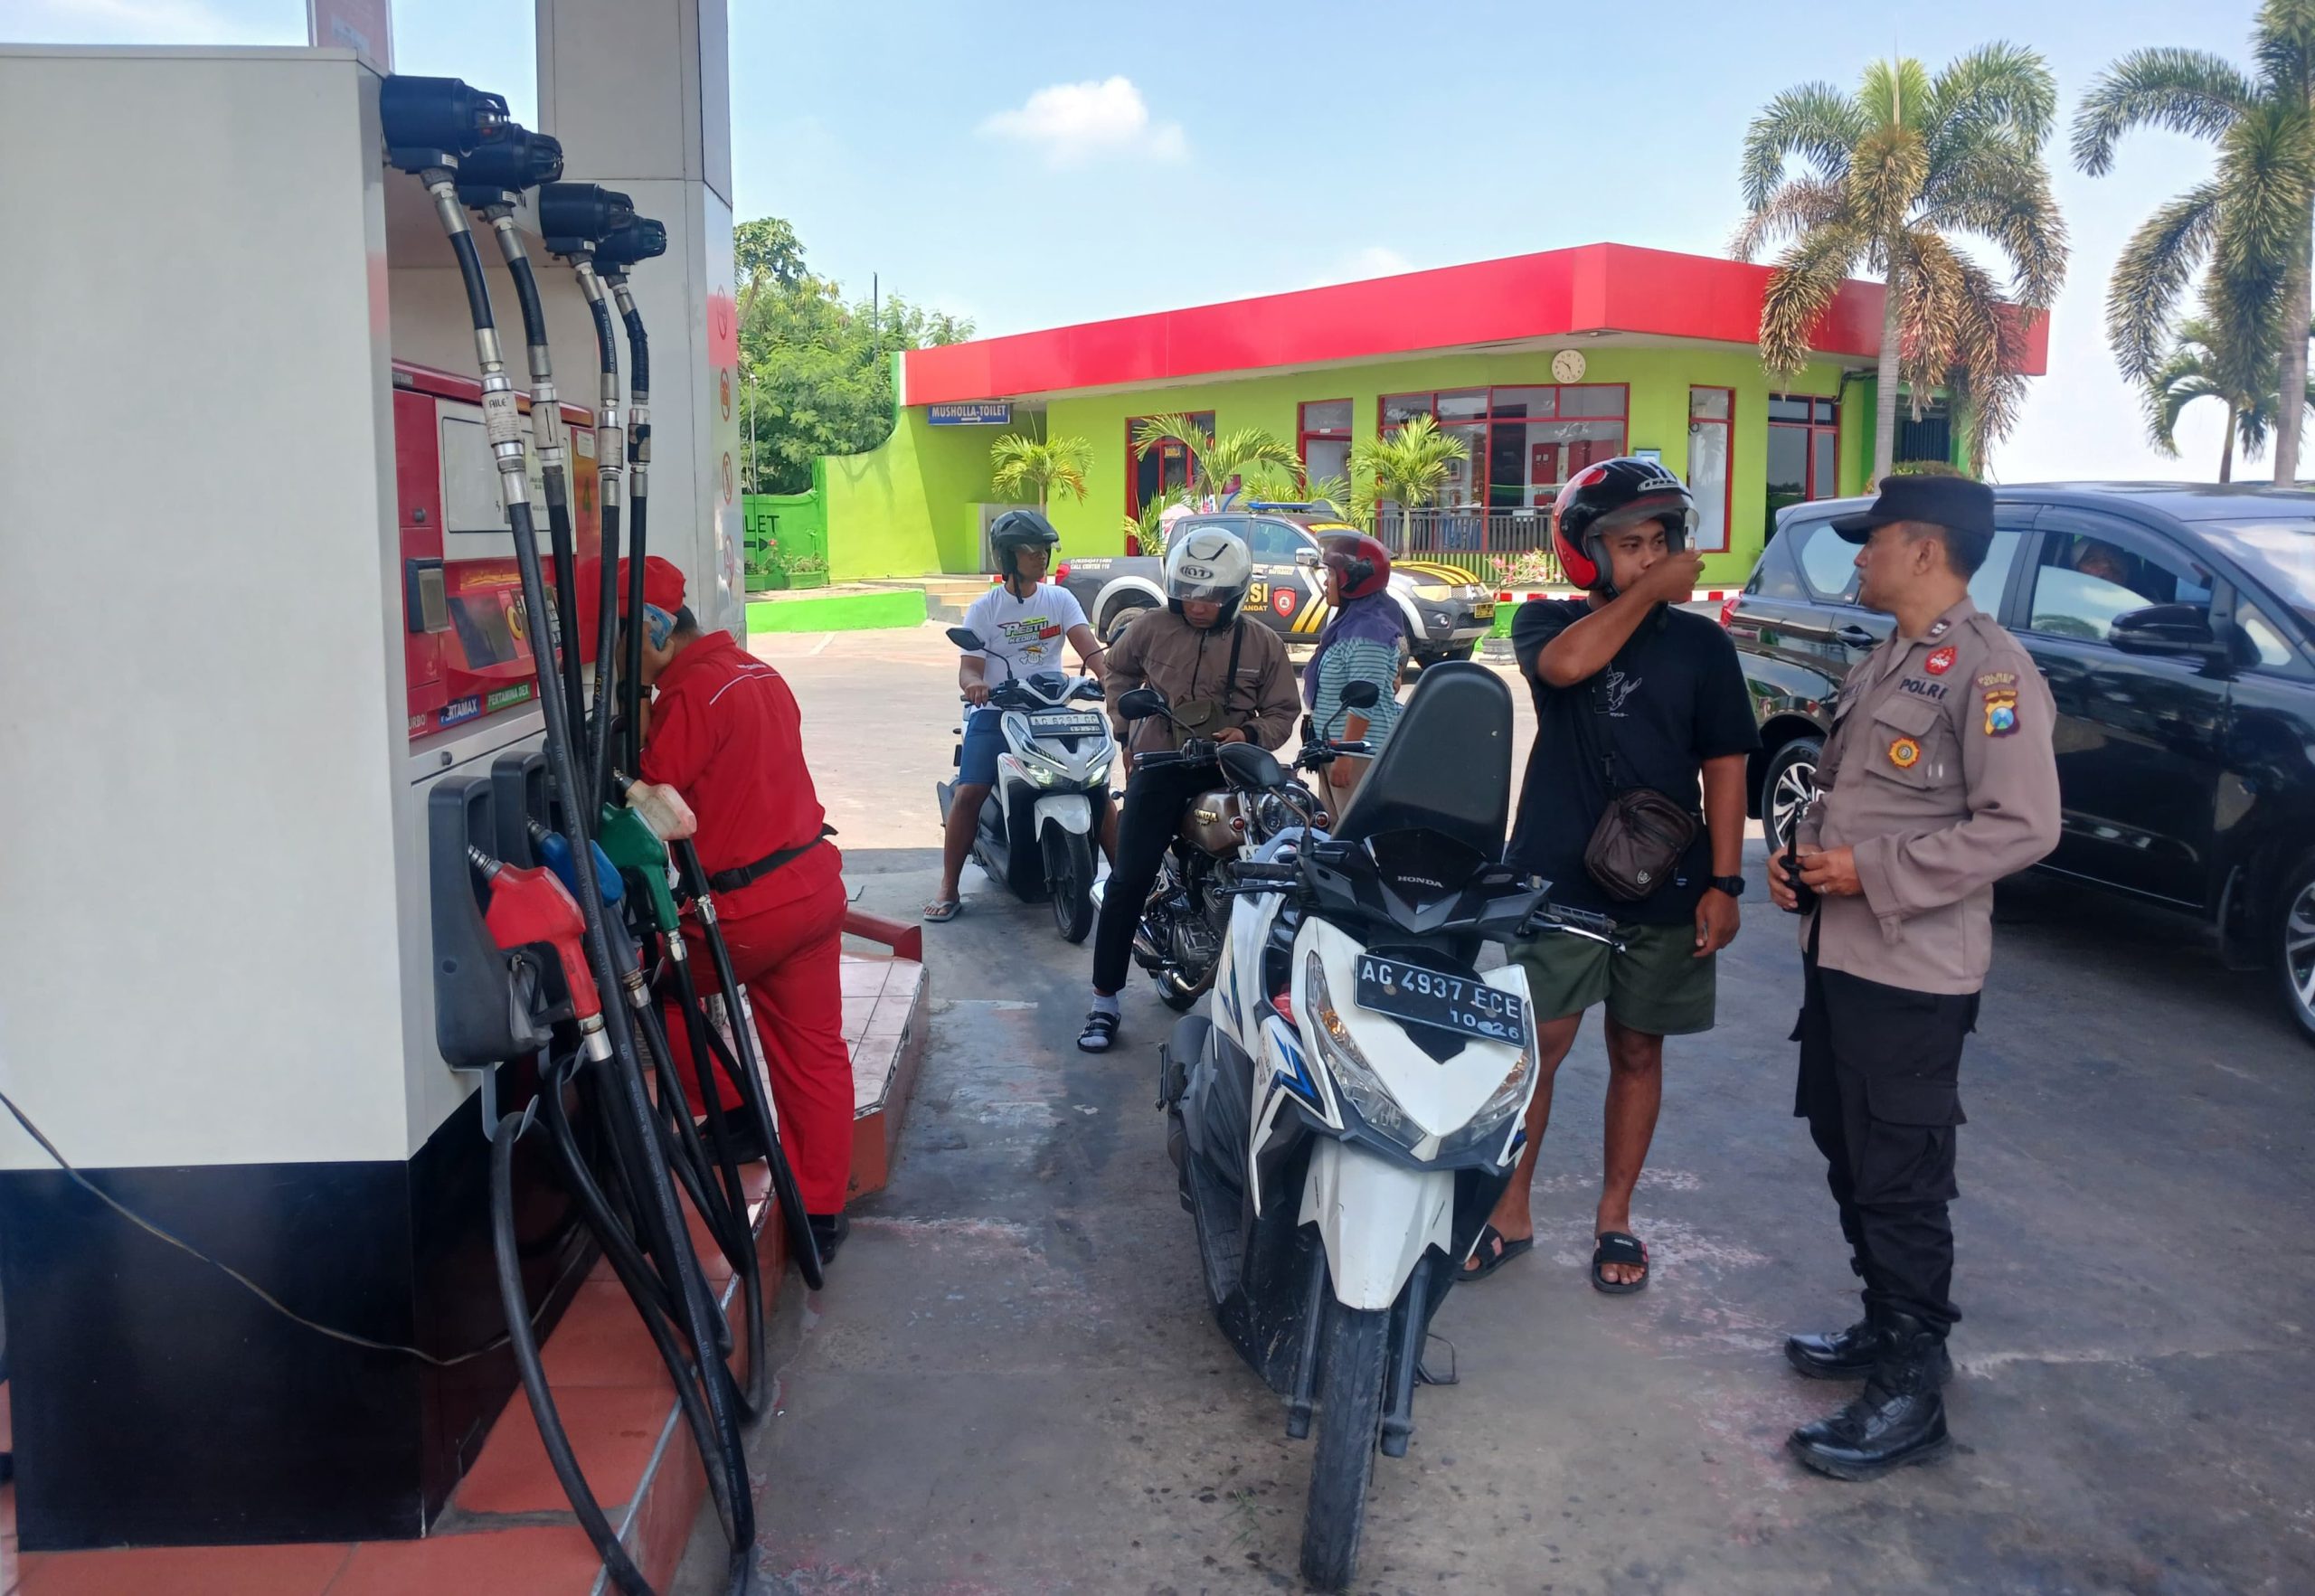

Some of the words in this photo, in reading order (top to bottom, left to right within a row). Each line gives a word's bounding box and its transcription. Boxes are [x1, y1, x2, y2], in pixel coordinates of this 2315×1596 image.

[931, 405, 1006, 418] MUSHOLLA-TOILET
[487, 688, 517, 705] PERTAMINA
[1899, 678, 1948, 701] POLRI
[1397, 875, 1443, 888] HONDA
[1361, 960, 1393, 985] AG
[1401, 970, 1462, 1001] 4937
[1474, 987, 1520, 1019] ECE
